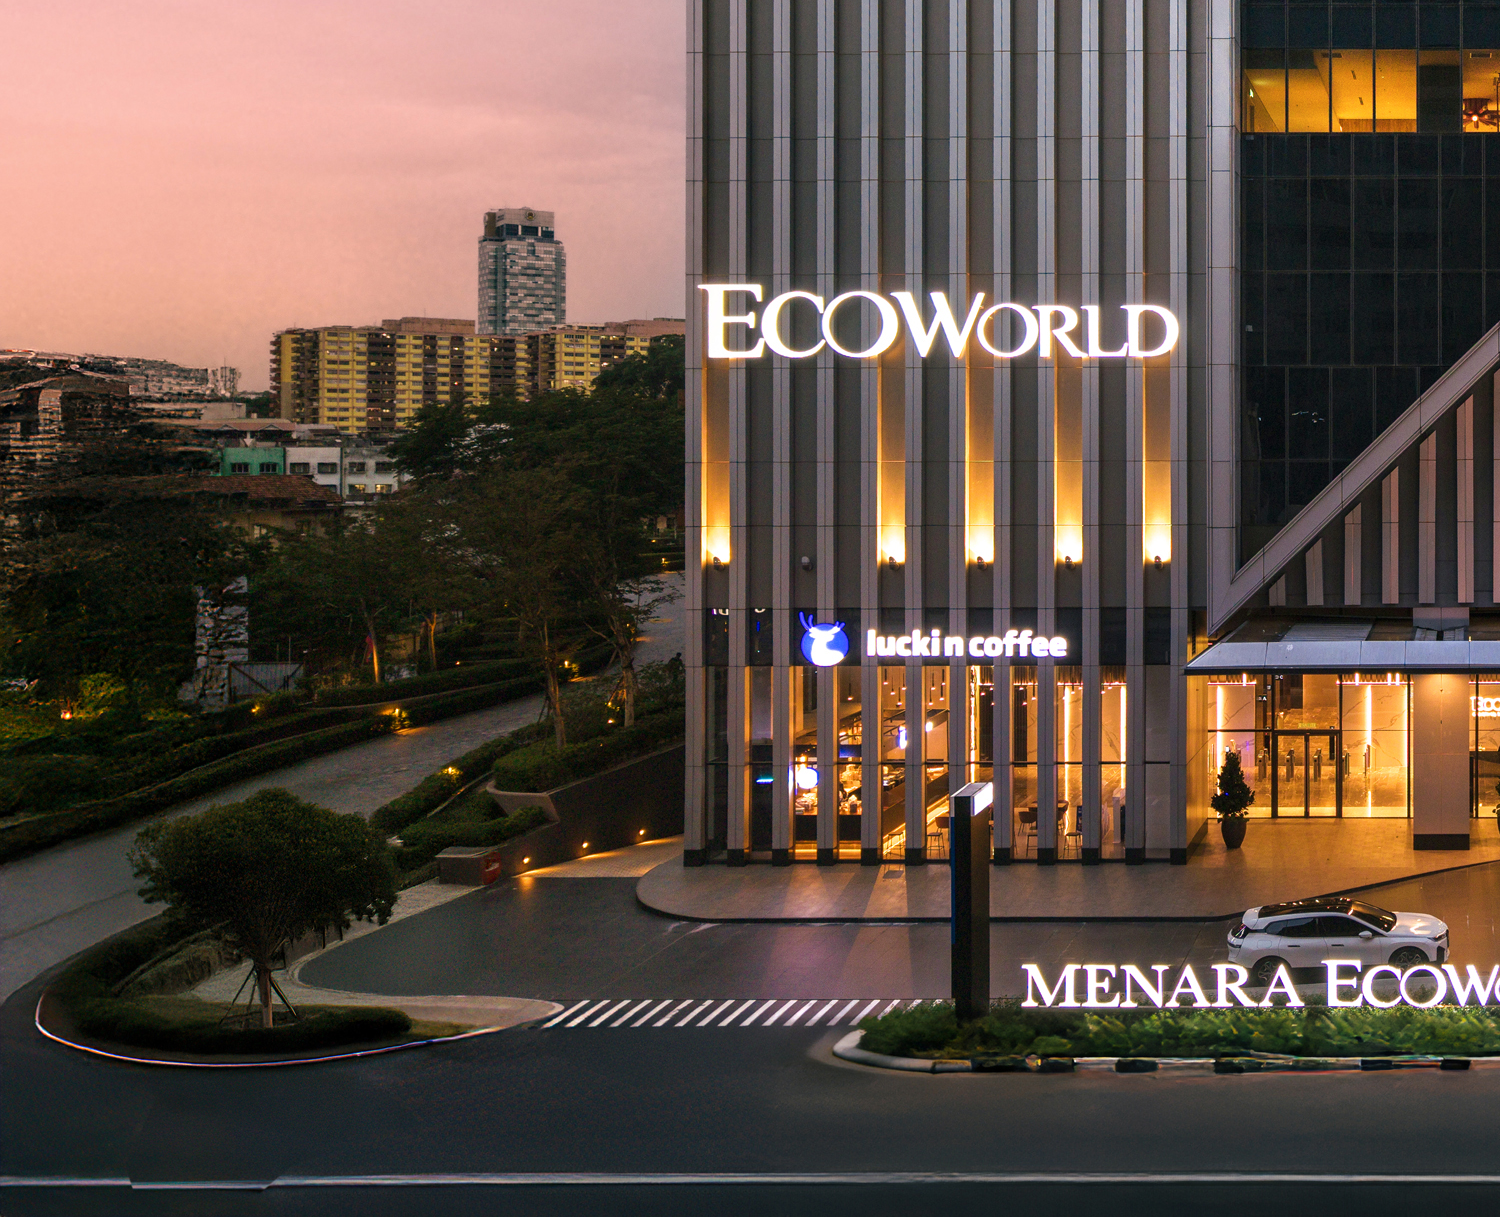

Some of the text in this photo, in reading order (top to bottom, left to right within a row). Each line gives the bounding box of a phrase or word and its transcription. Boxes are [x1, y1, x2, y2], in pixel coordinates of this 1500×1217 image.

[867, 629, 1067, 658] luckin coffee
[1021, 964, 1305, 1008] MENARA
